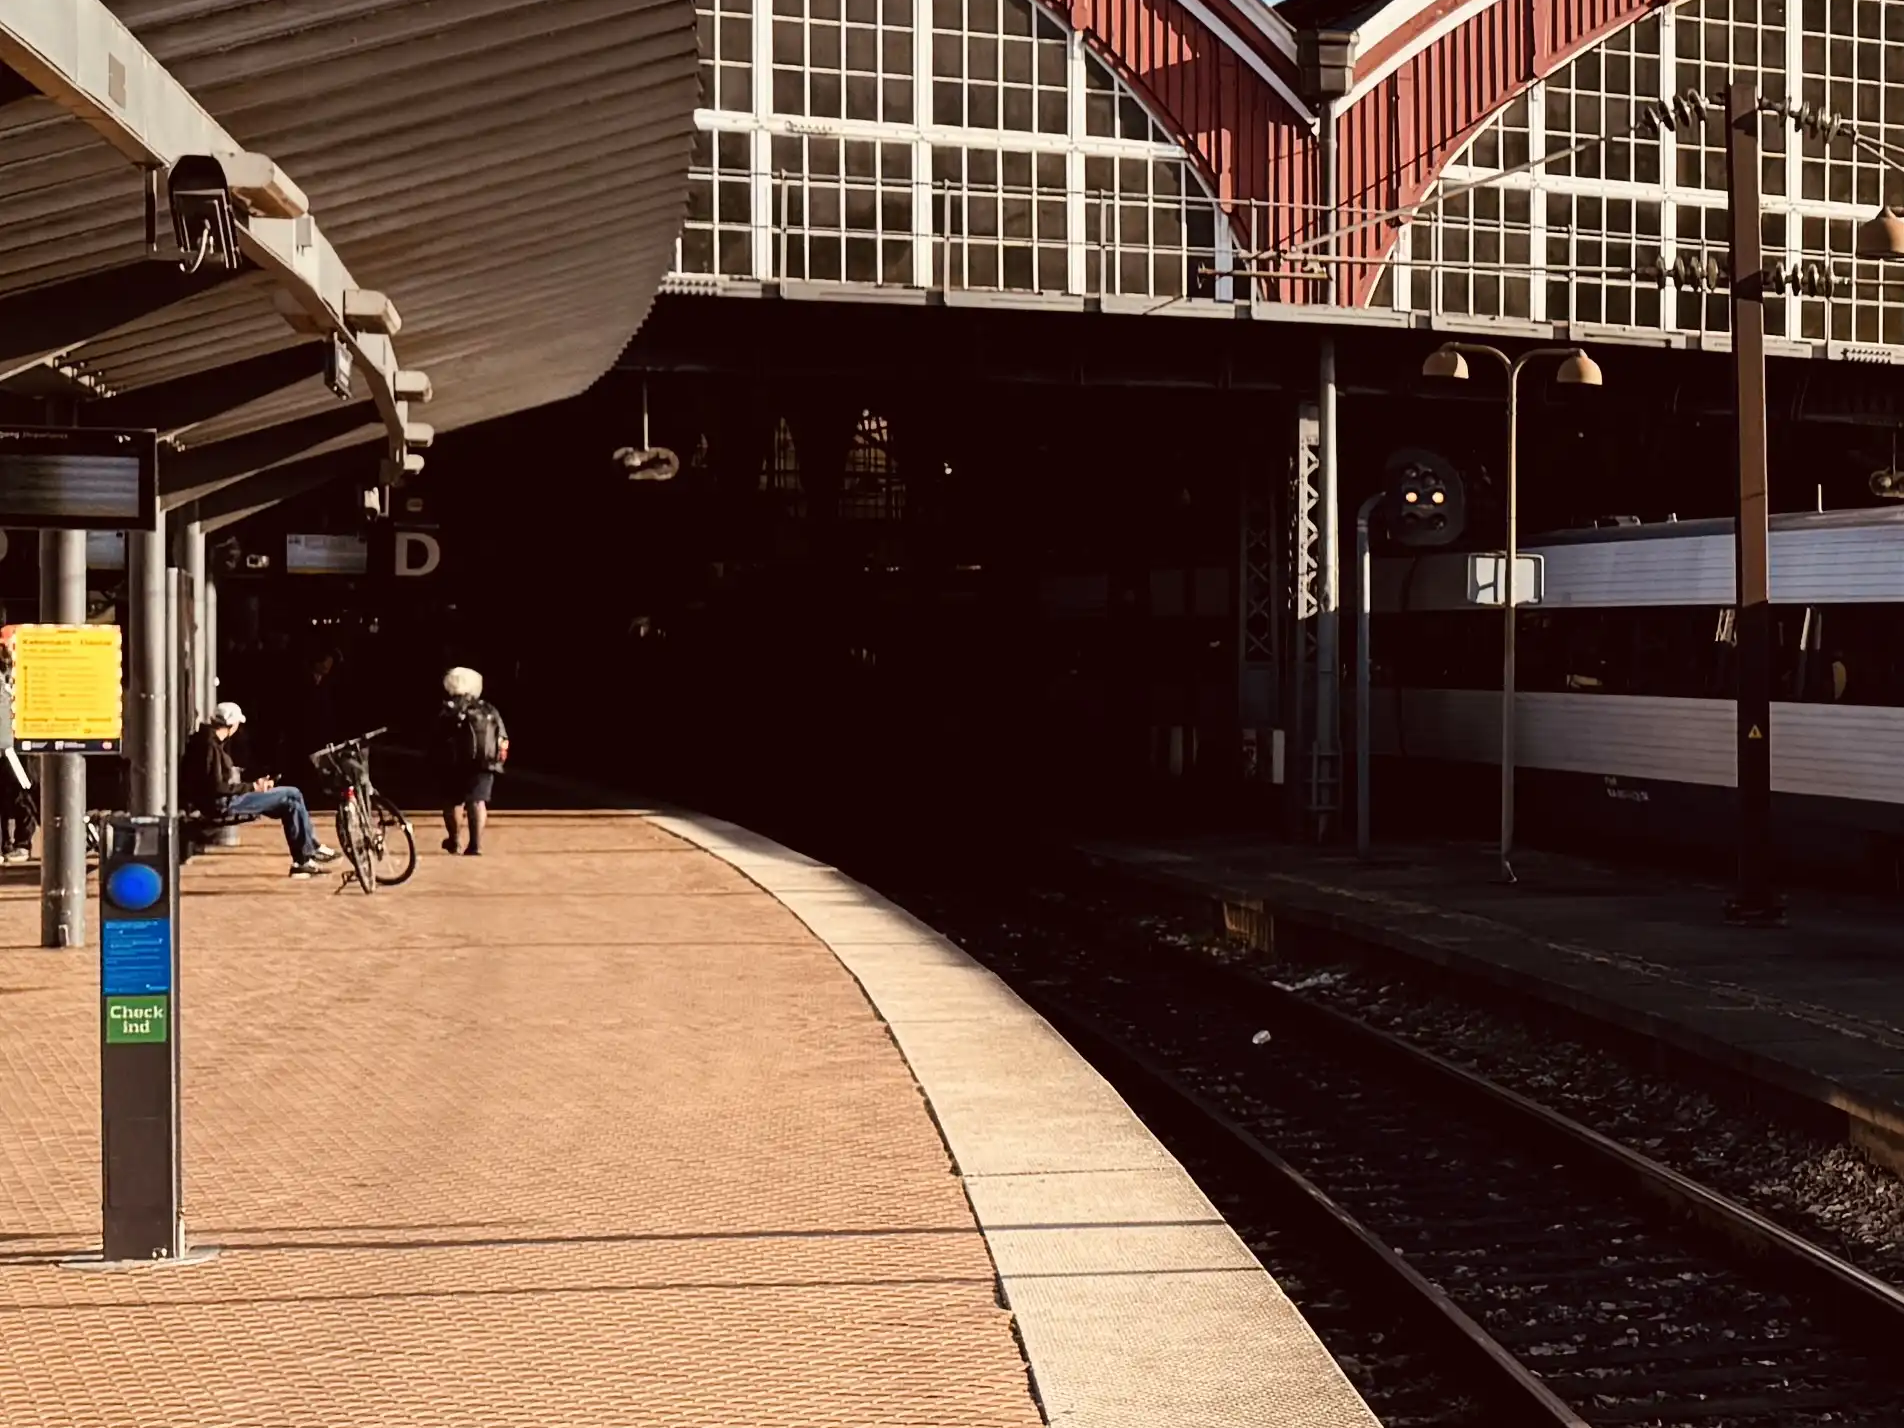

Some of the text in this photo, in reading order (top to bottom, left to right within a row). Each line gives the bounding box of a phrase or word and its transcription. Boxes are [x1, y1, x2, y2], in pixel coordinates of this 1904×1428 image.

[394, 531, 441, 577] D
[110, 1004, 164, 1020] Check
[122, 1019, 151, 1034] ind
